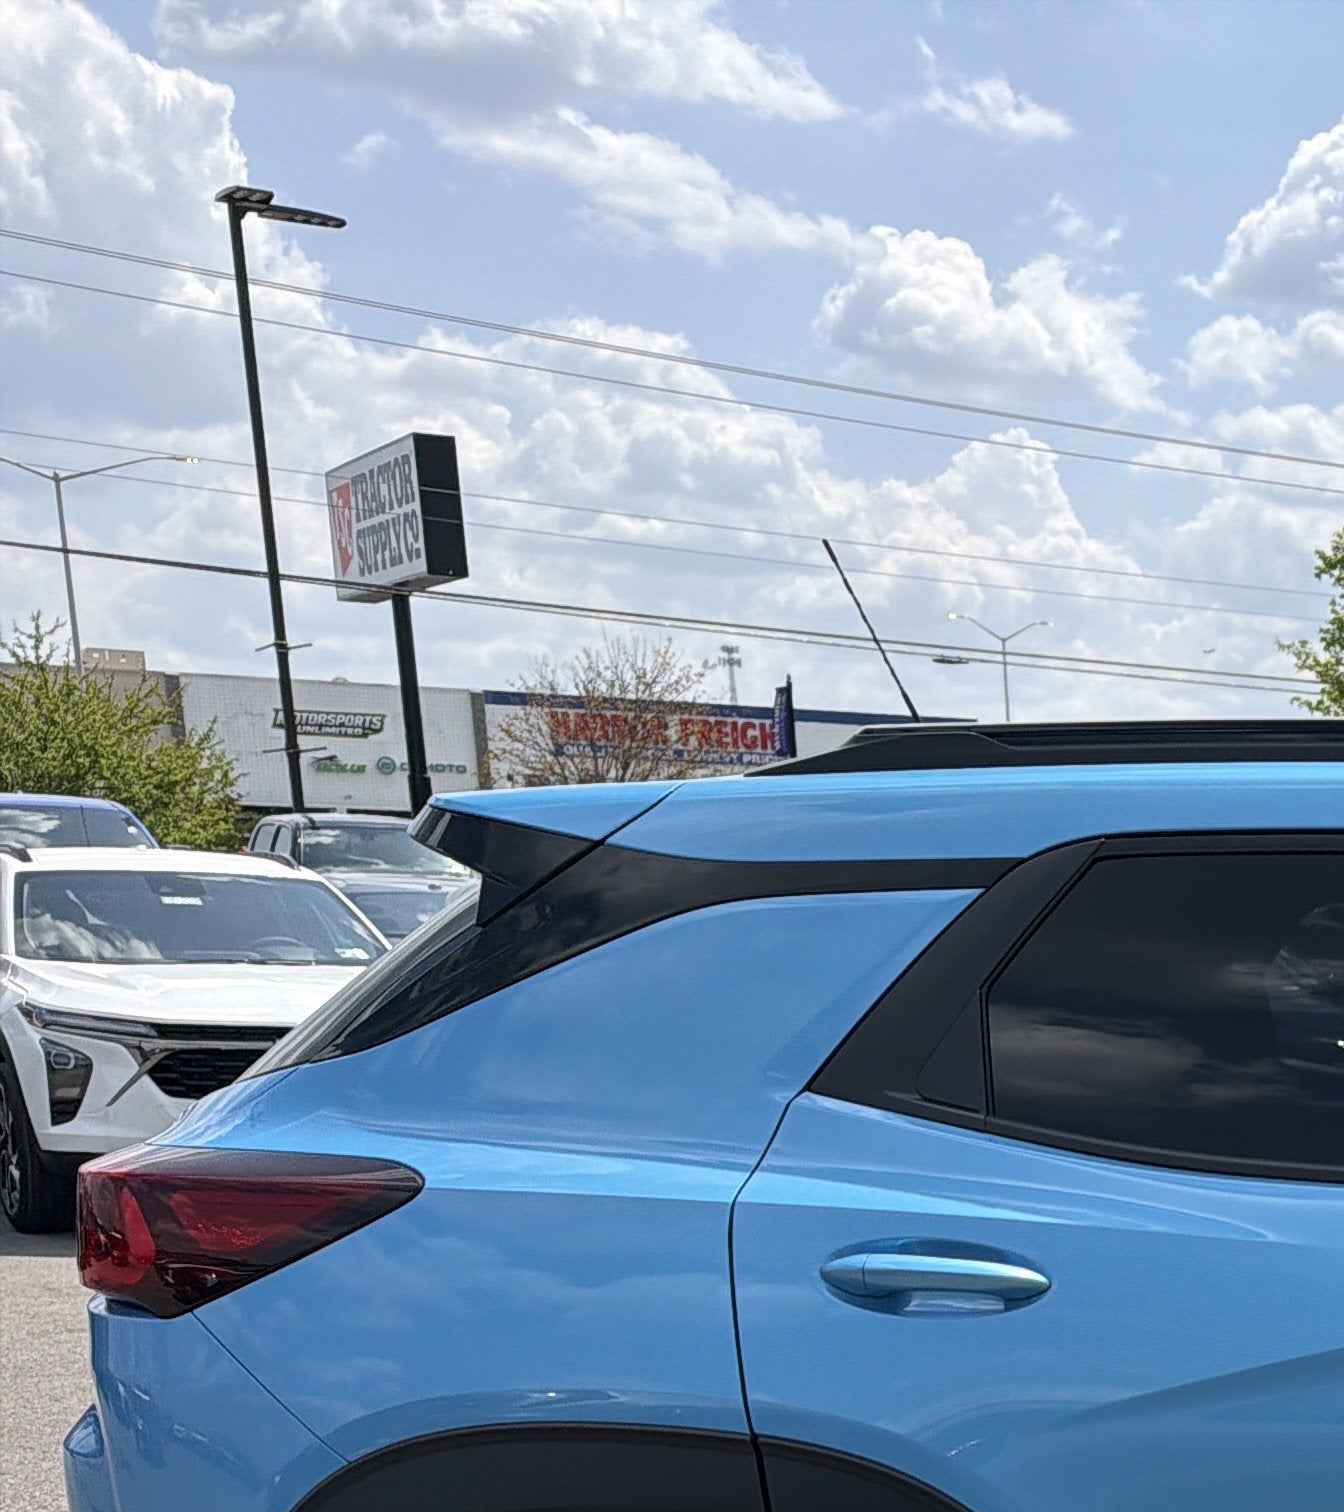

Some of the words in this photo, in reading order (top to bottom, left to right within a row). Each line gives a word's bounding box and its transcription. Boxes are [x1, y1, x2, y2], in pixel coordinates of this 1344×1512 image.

[351, 453, 416, 523] TRACTOR
[356, 515, 404, 577] SUPPLY
[550, 710, 669, 746] HARBR
[680, 718, 777, 752] FREIGH
[400, 762, 467, 774] COTO
